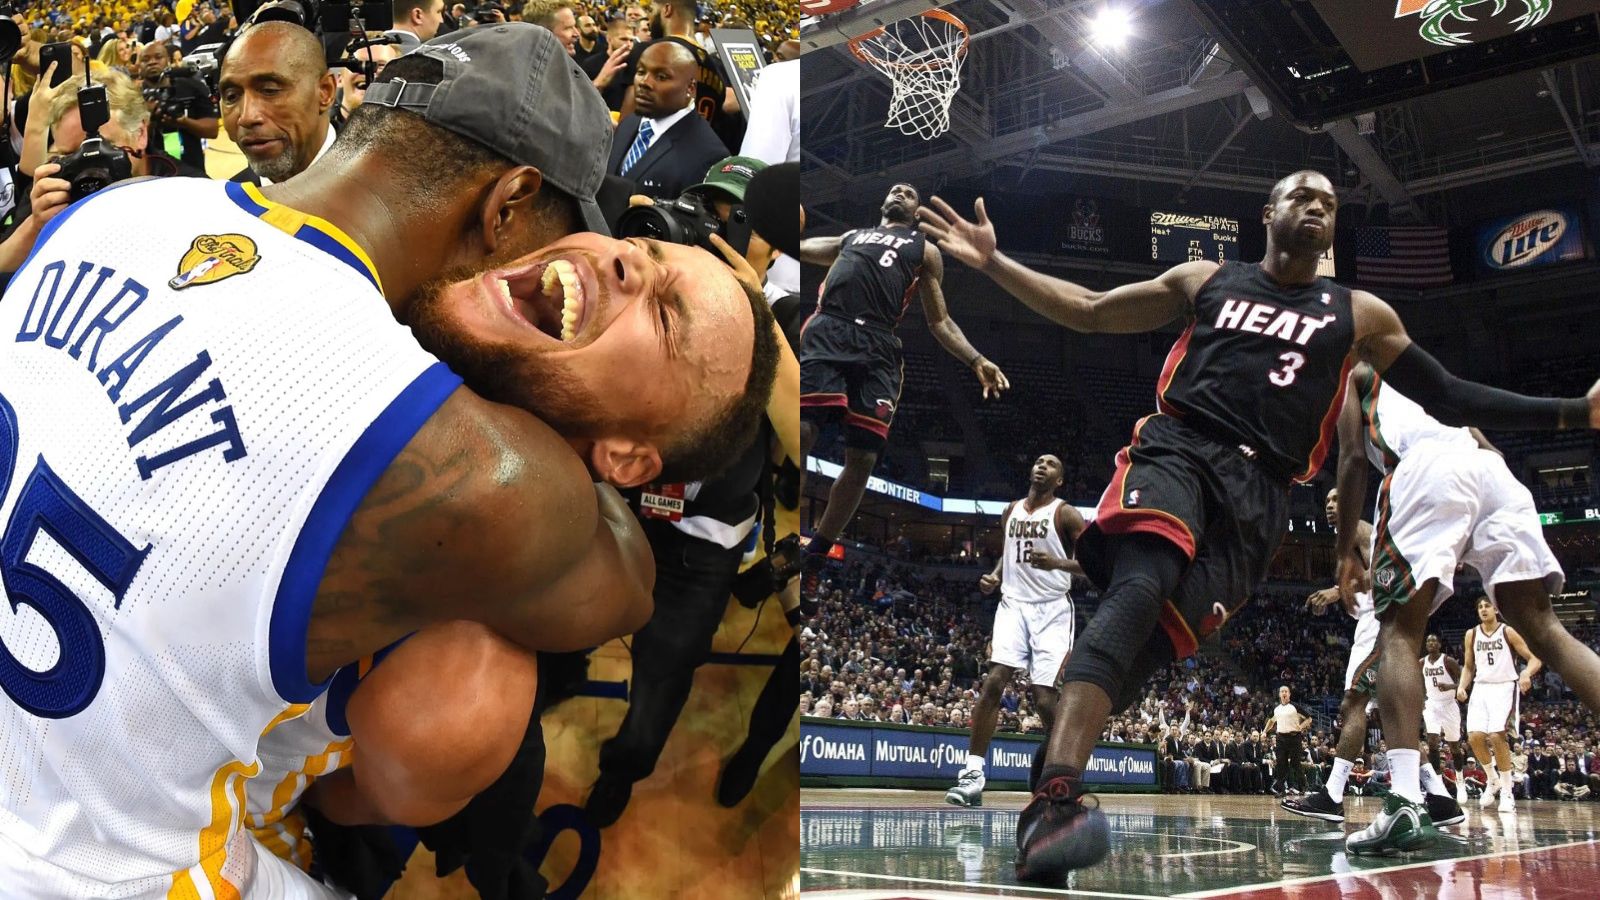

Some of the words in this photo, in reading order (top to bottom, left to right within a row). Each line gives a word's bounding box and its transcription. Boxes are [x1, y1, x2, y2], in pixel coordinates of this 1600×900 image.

[1203, 215, 1228, 224] TEAM
[852, 231, 914, 249] HEAT
[1070, 226, 1102, 241] BUCKS
[1502, 221, 1559, 266] Lite
[879, 249, 898, 268] 6
[1214, 299, 1337, 346] HEAT
[15, 260, 248, 481] DURANT
[1268, 351, 1305, 387] 3
[644, 495, 656, 505] ALL
[658, 497, 681, 509] GAMES
[1008, 517, 1049, 539] BUCKS
[0, 391, 153, 719] 5
[1015, 540, 1033, 563] 12
[1476, 638, 1503, 652] BUCKS
[1487, 651, 1495, 665] 6
[1424, 665, 1445, 677] BUCKS
[812, 736, 865, 761] OMAHA
[876, 740, 928, 763] MUTUAL
[930, 743, 944, 768] of
[1127, 757, 1153, 774] OMAHA
